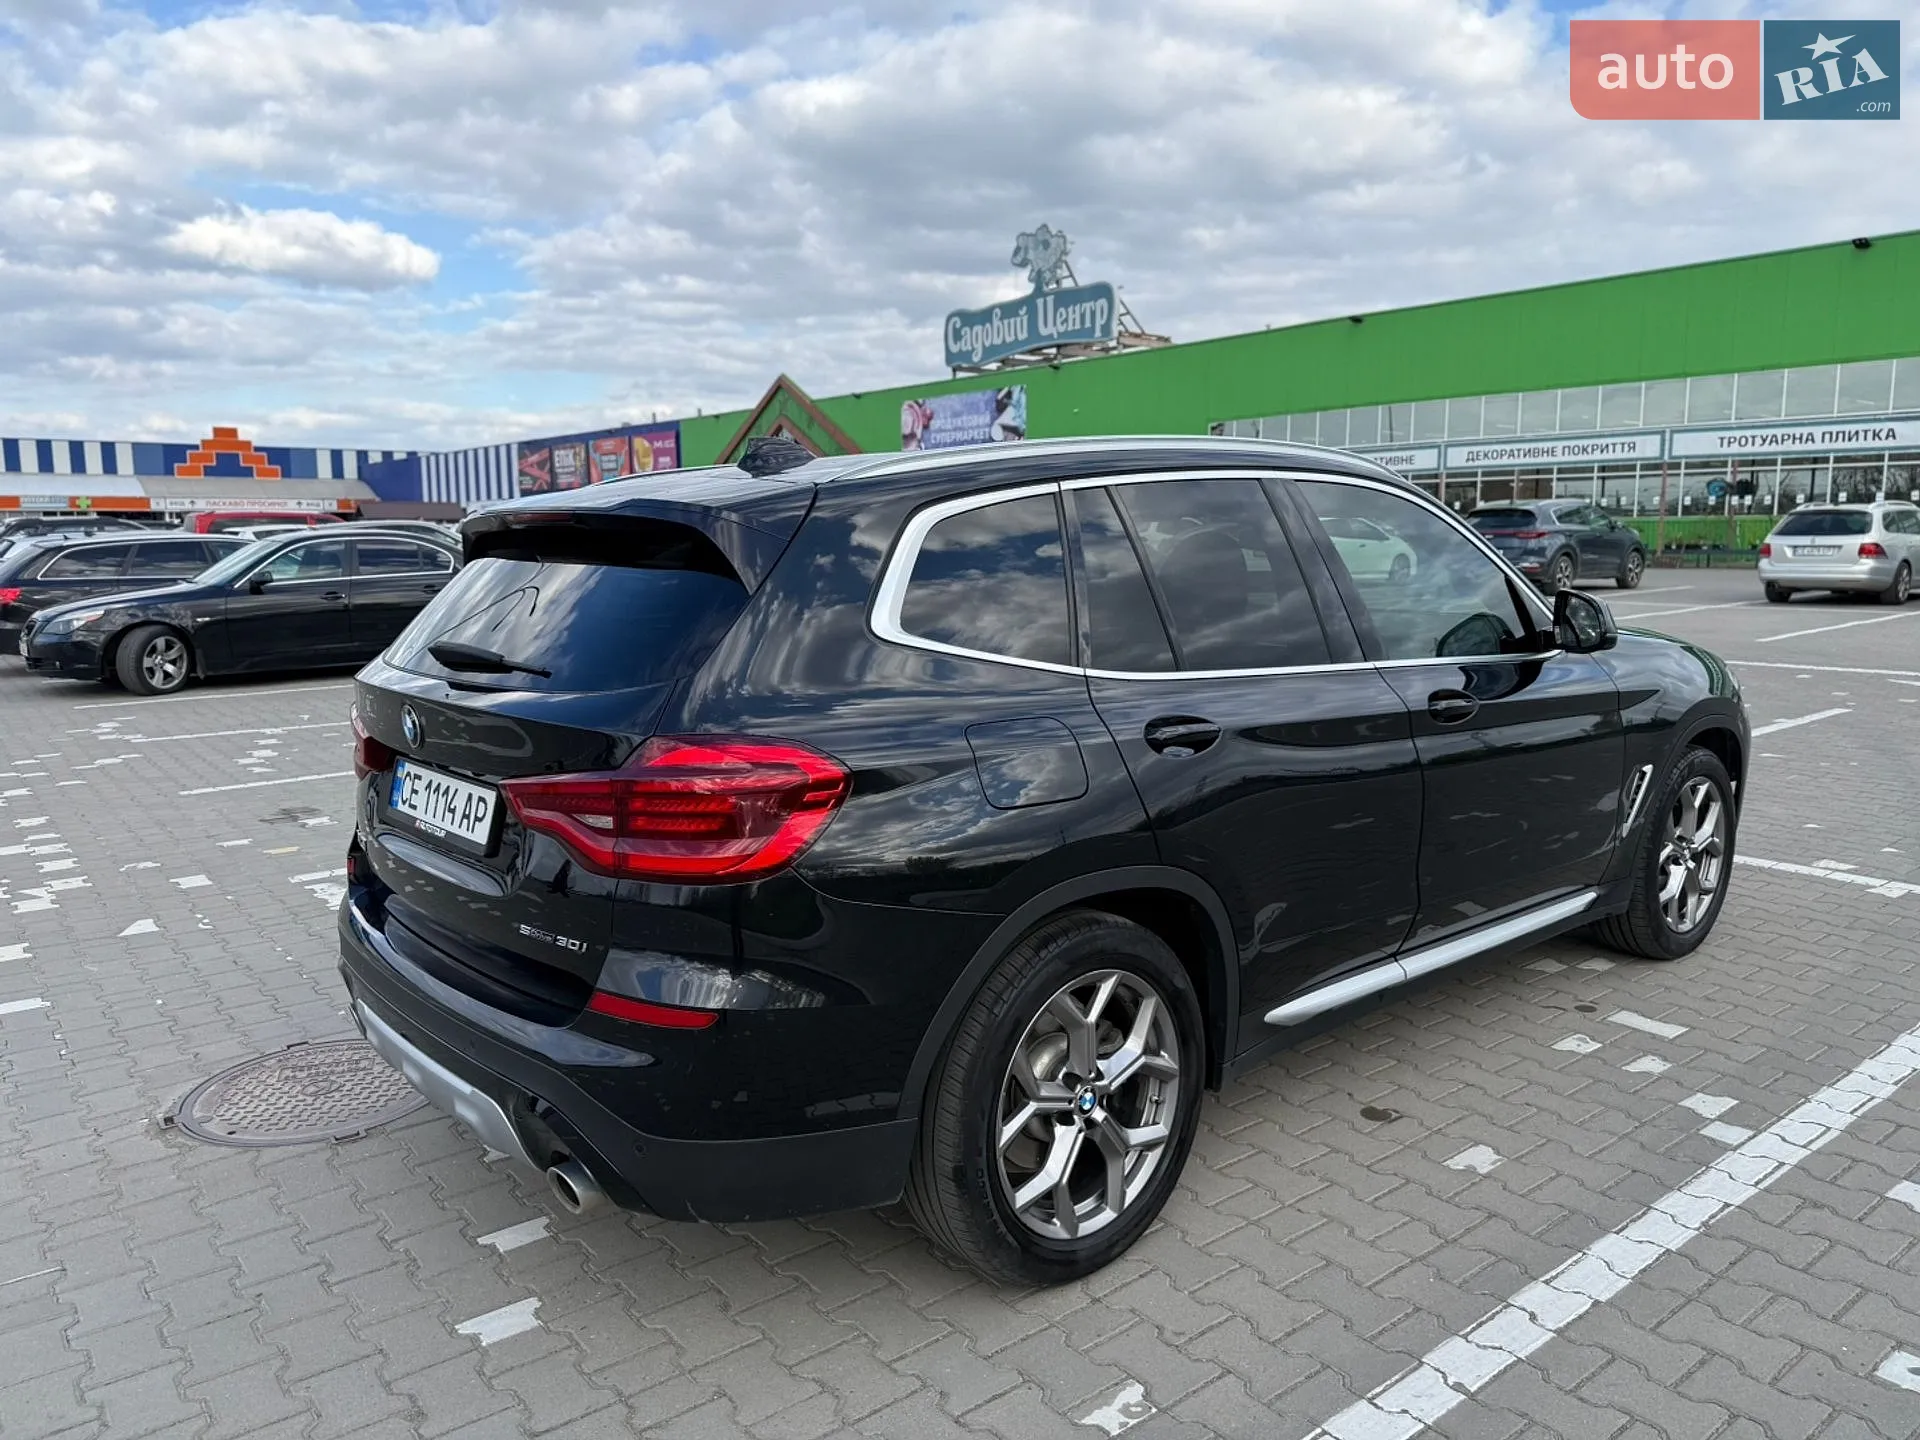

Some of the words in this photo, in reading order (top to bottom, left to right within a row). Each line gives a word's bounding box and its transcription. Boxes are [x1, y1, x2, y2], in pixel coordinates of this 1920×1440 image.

[947, 304, 1029, 362] Садовий
[1035, 295, 1109, 340] Центр
[1465, 447, 1558, 463] ДЕКОРАТИВНЕ
[1561, 441, 1637, 457] ПОКРИТТЯ
[1717, 432, 1816, 448] ТРОТУАРНА
[1820, 427, 1897, 444] ПЛИТКА
[401, 771, 423, 811] CE
[424, 778, 459, 826] 1114
[458, 791, 488, 834] AP
